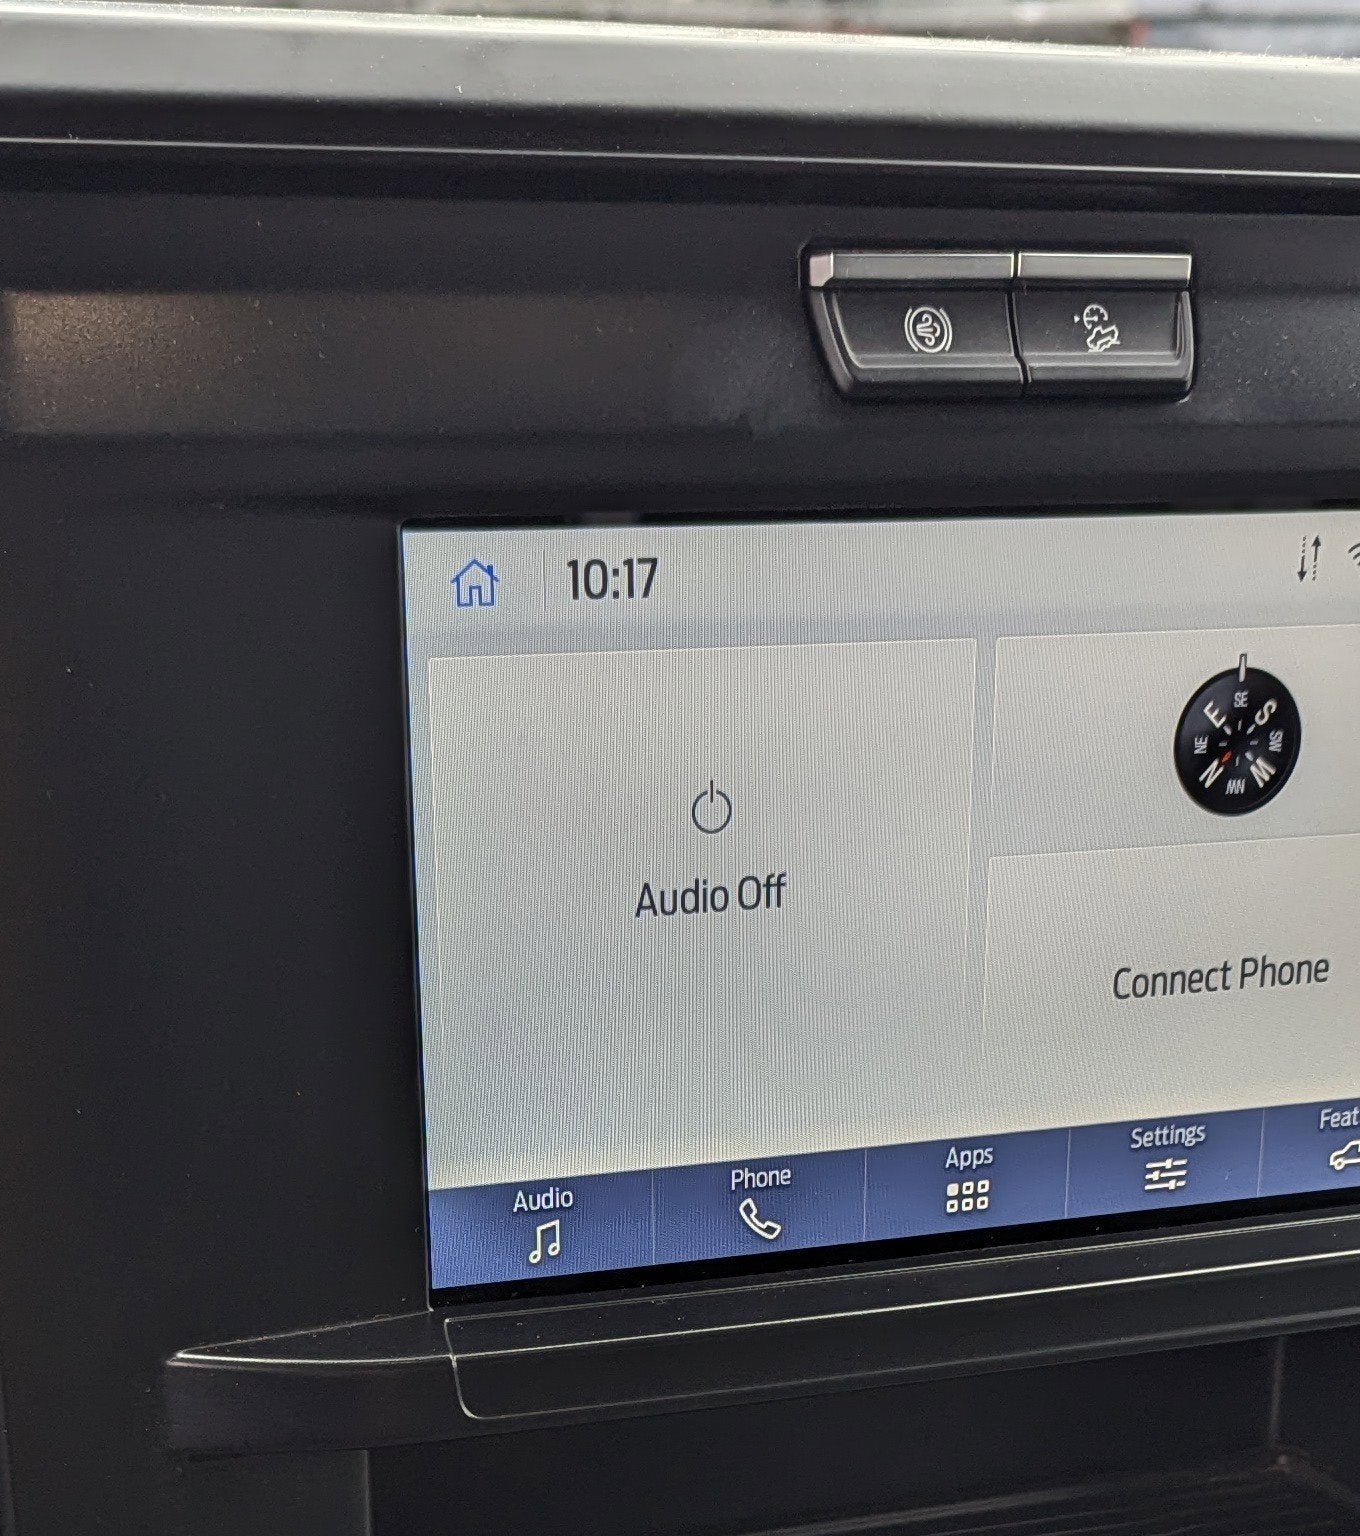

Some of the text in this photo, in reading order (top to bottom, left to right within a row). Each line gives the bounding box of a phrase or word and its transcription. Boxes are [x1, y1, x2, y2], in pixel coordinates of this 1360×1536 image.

[566, 556, 659, 600] 10:17
[1232, 690, 1249, 708] SE
[1254, 698, 1278, 726] S
[1203, 700, 1228, 729] E
[1193, 735, 1209, 755] NE
[1268, 729, 1285, 753] SW
[1199, 757, 1225, 789] N
[1225, 778, 1246, 795] NW
[1249, 756, 1277, 789] W
[635, 872, 787, 918] Audio Off
[1113, 954, 1331, 1000] Connect Phone
[1130, 1122, 1207, 1150] Settings
[945, 1143, 994, 1170] Apps
[730, 1166, 792, 1191] Phone
[512, 1187, 574, 1213] Audio
